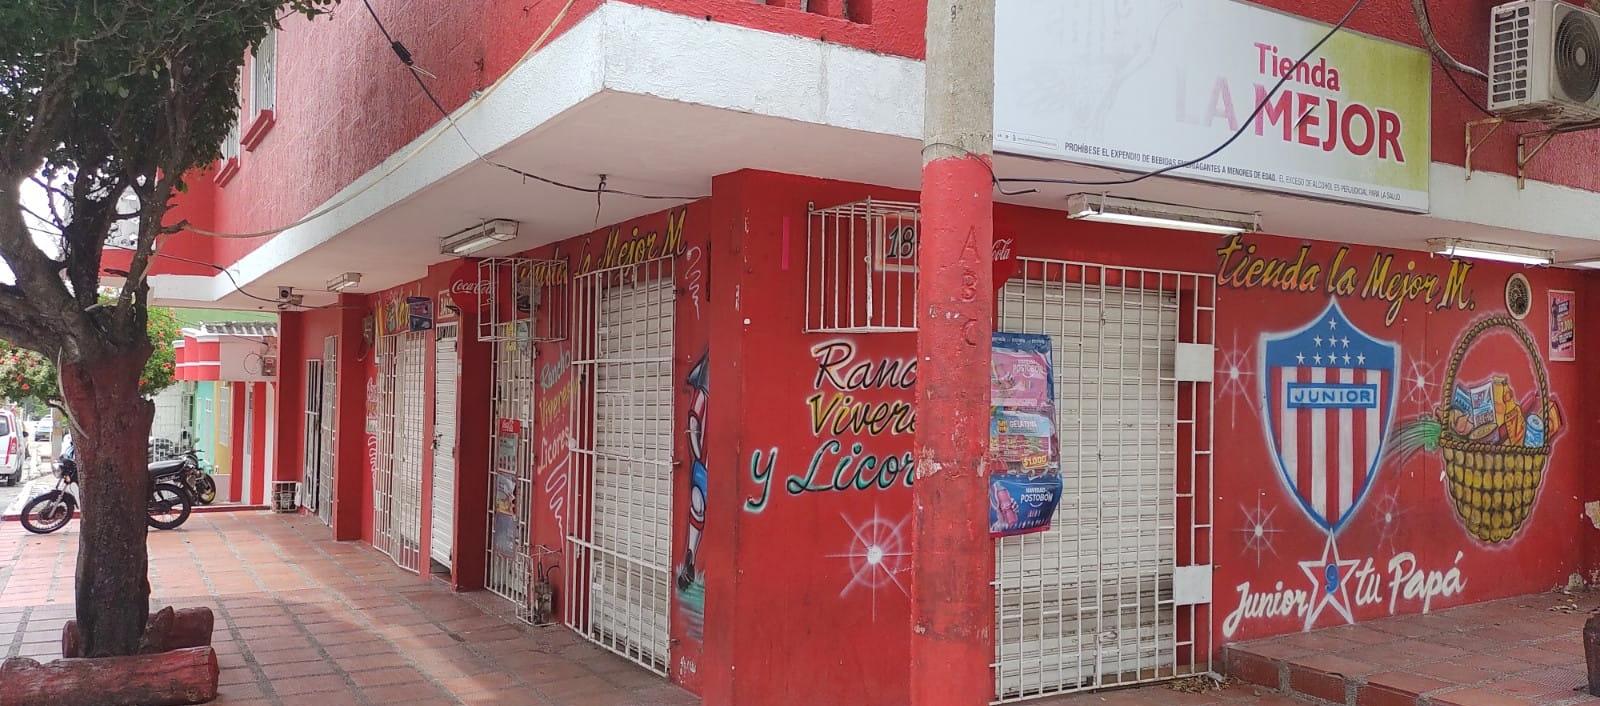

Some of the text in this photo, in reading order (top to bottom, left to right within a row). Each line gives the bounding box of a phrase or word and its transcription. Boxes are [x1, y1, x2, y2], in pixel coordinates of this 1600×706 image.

[1254, 42, 1340, 92] Tienda
[1176, 65, 1405, 163] LA MEJOR
[1101, 147, 1109, 157] EL
[1110, 149, 1140, 162] EXPENDIO
[1142, 153, 1150, 163] DE
[1151, 155, 1177, 168] BEBIDAS
[1227, 166, 1253, 178] MENORES
[1253, 171, 1261, 179] DE
[598, 226, 657, 279] Mejor
[991, 237, 1014, 262] ola
[1327, 246, 1357, 296] la
[1361, 252, 1441, 327] Mejor
[811, 338, 917, 391] Ranc
[806, 392, 915, 437] Viver
[1293, 387, 1372, 404] JUNIOR
[786, 438, 914, 496] Licor
[1324, 564, 1339, 593] 9
[1352, 550, 1468, 615] tu Papá
[1222, 580, 1310, 638] Junior
